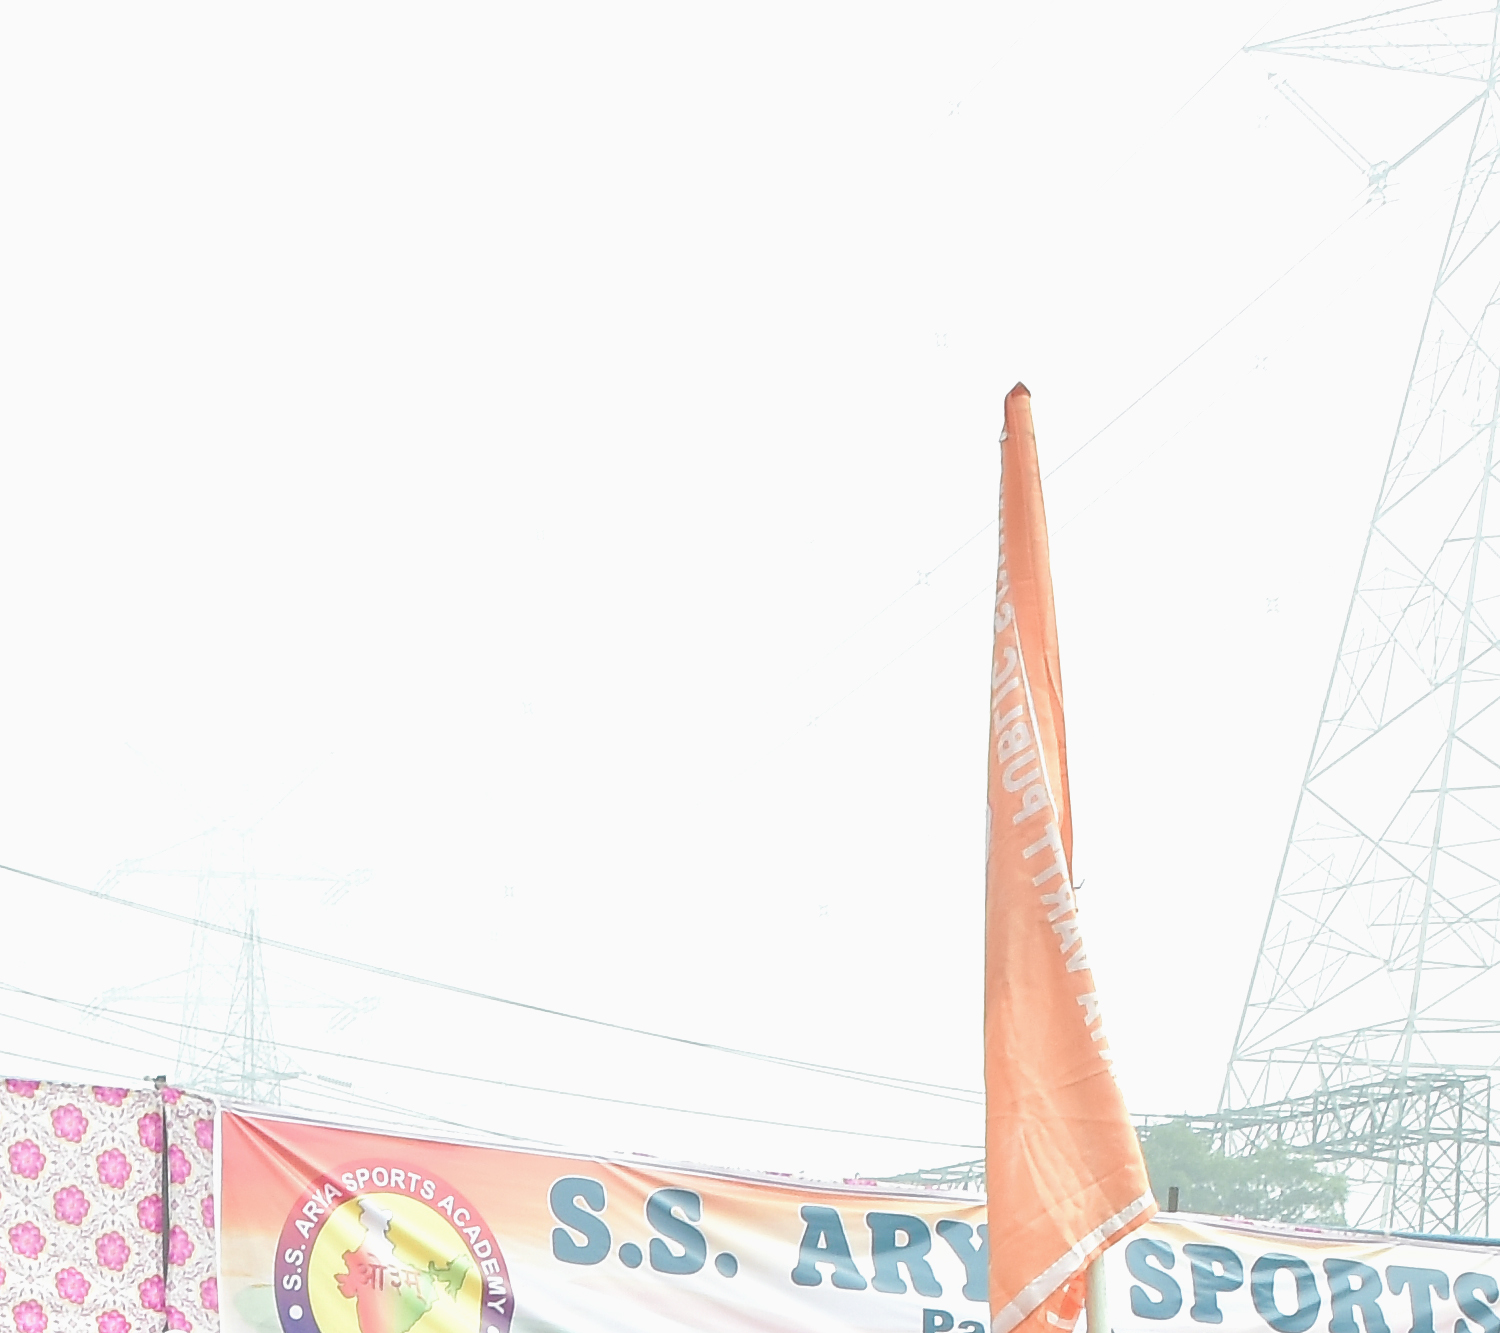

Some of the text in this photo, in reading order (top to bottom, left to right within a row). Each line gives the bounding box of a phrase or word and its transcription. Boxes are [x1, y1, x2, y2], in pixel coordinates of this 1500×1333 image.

[283, 1167, 505, 1314] S.S. ARYA SPORTS ACADEMY
[550, 1178, 738, 1278] S.S.
[791, 1205, 989, 1302] ARY
